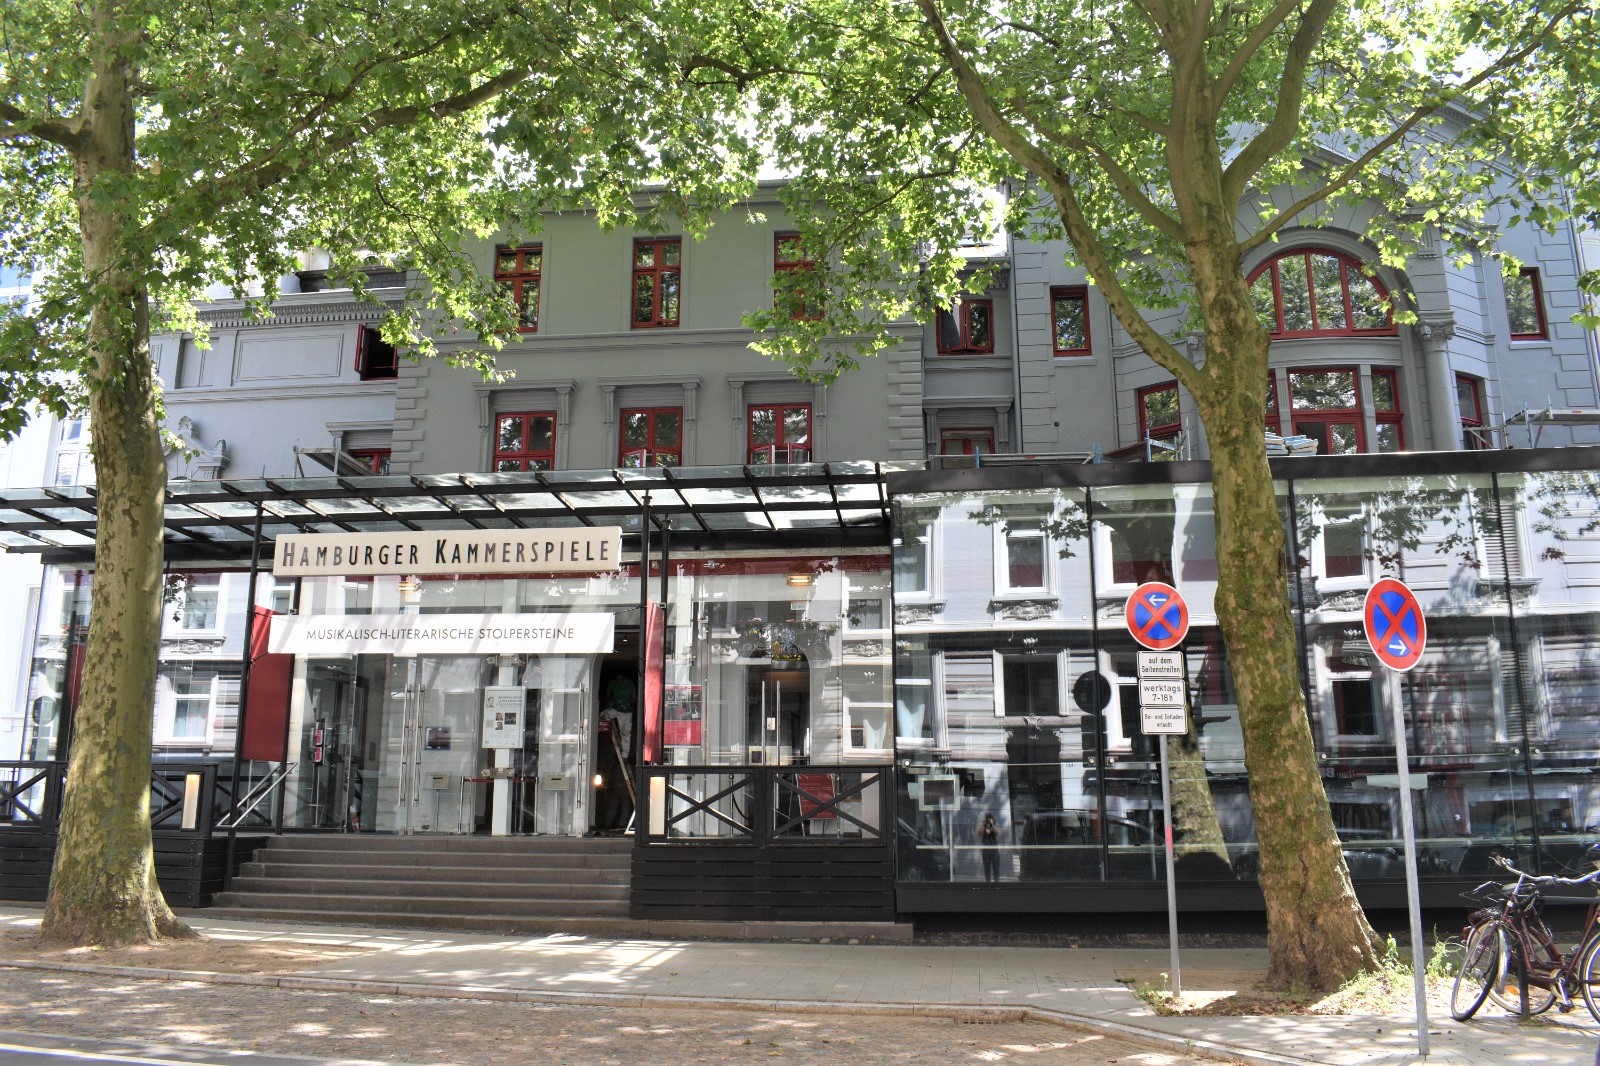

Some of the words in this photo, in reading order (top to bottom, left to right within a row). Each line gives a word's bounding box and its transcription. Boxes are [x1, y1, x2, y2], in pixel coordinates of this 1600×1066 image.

[282, 542, 418, 567] HAMBURGER
[435, 539, 609, 564] KAMMERSPIELE
[306, 628, 474, 640] MUSIKALISCH-LITERARISCHE
[478, 628, 574, 639] STOLPERSTEINE
[1143, 684, 1182, 694] werktags
